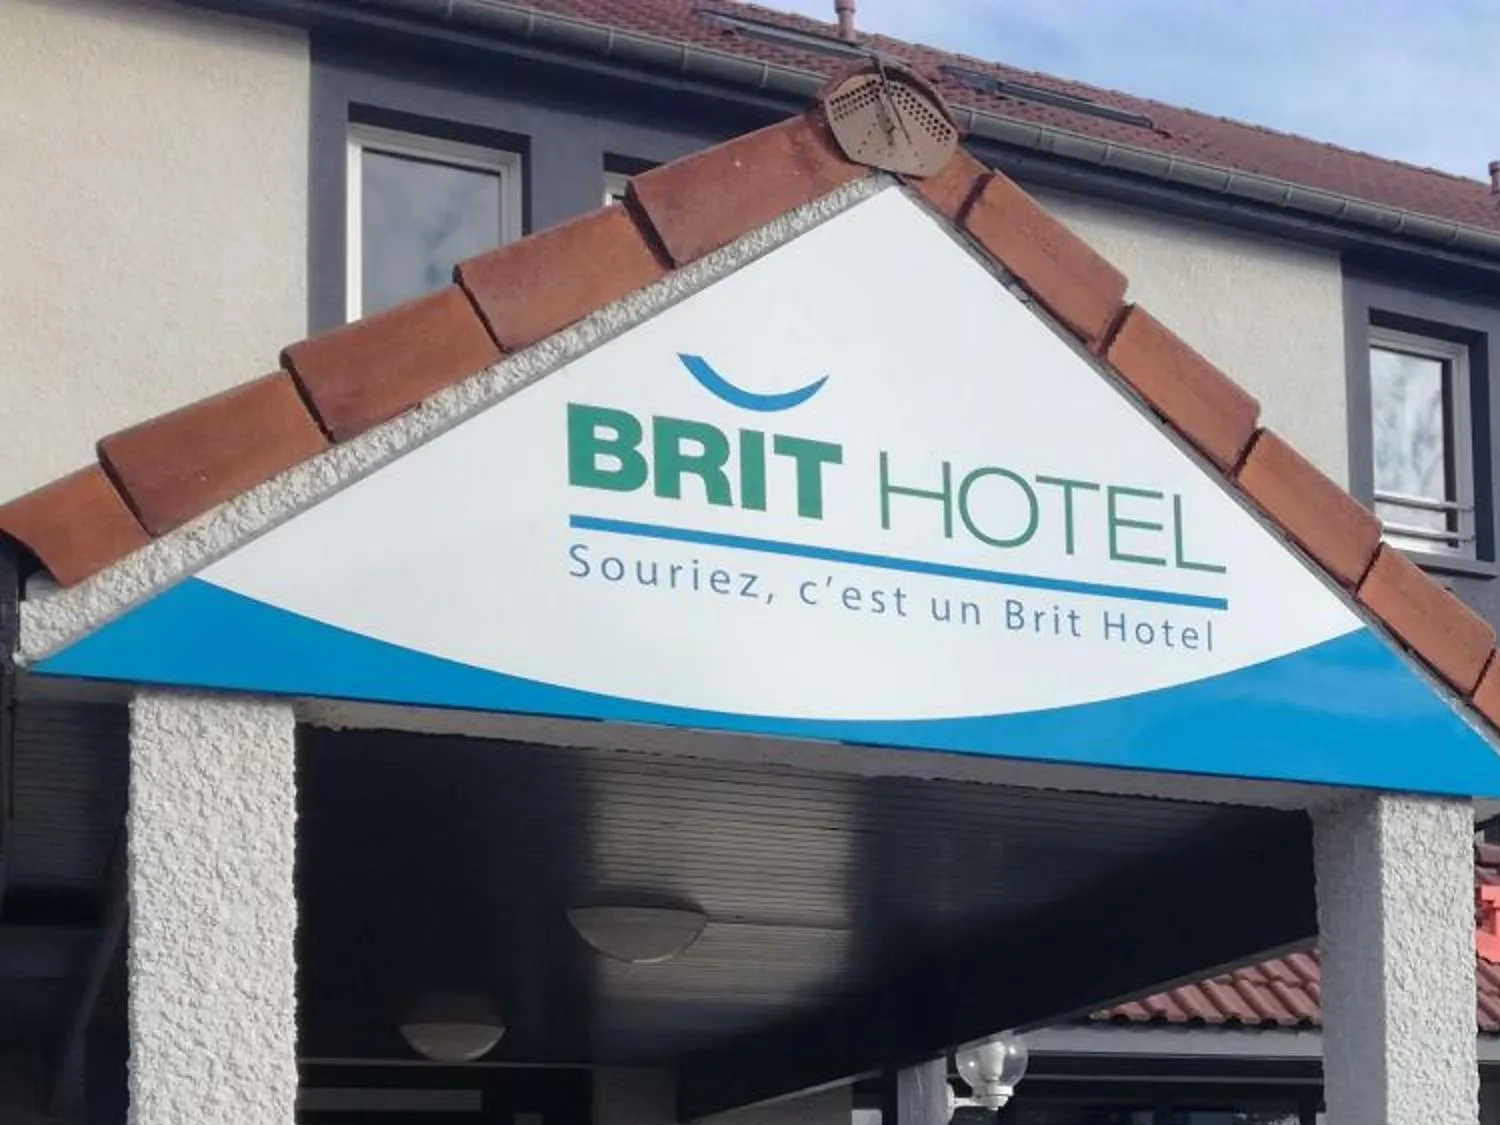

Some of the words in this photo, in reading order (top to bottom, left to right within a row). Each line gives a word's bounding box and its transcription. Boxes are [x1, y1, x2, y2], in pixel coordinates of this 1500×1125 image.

[568, 403, 842, 519] BRIT
[880, 452, 1226, 573] HOTEL
[569, 544, 773, 604] Souriez,
[799, 576, 907, 617] c'est
[931, 597, 981, 625] un
[1006, 600, 1081, 637] Brit
[1104, 611, 1213, 651] Hotel
